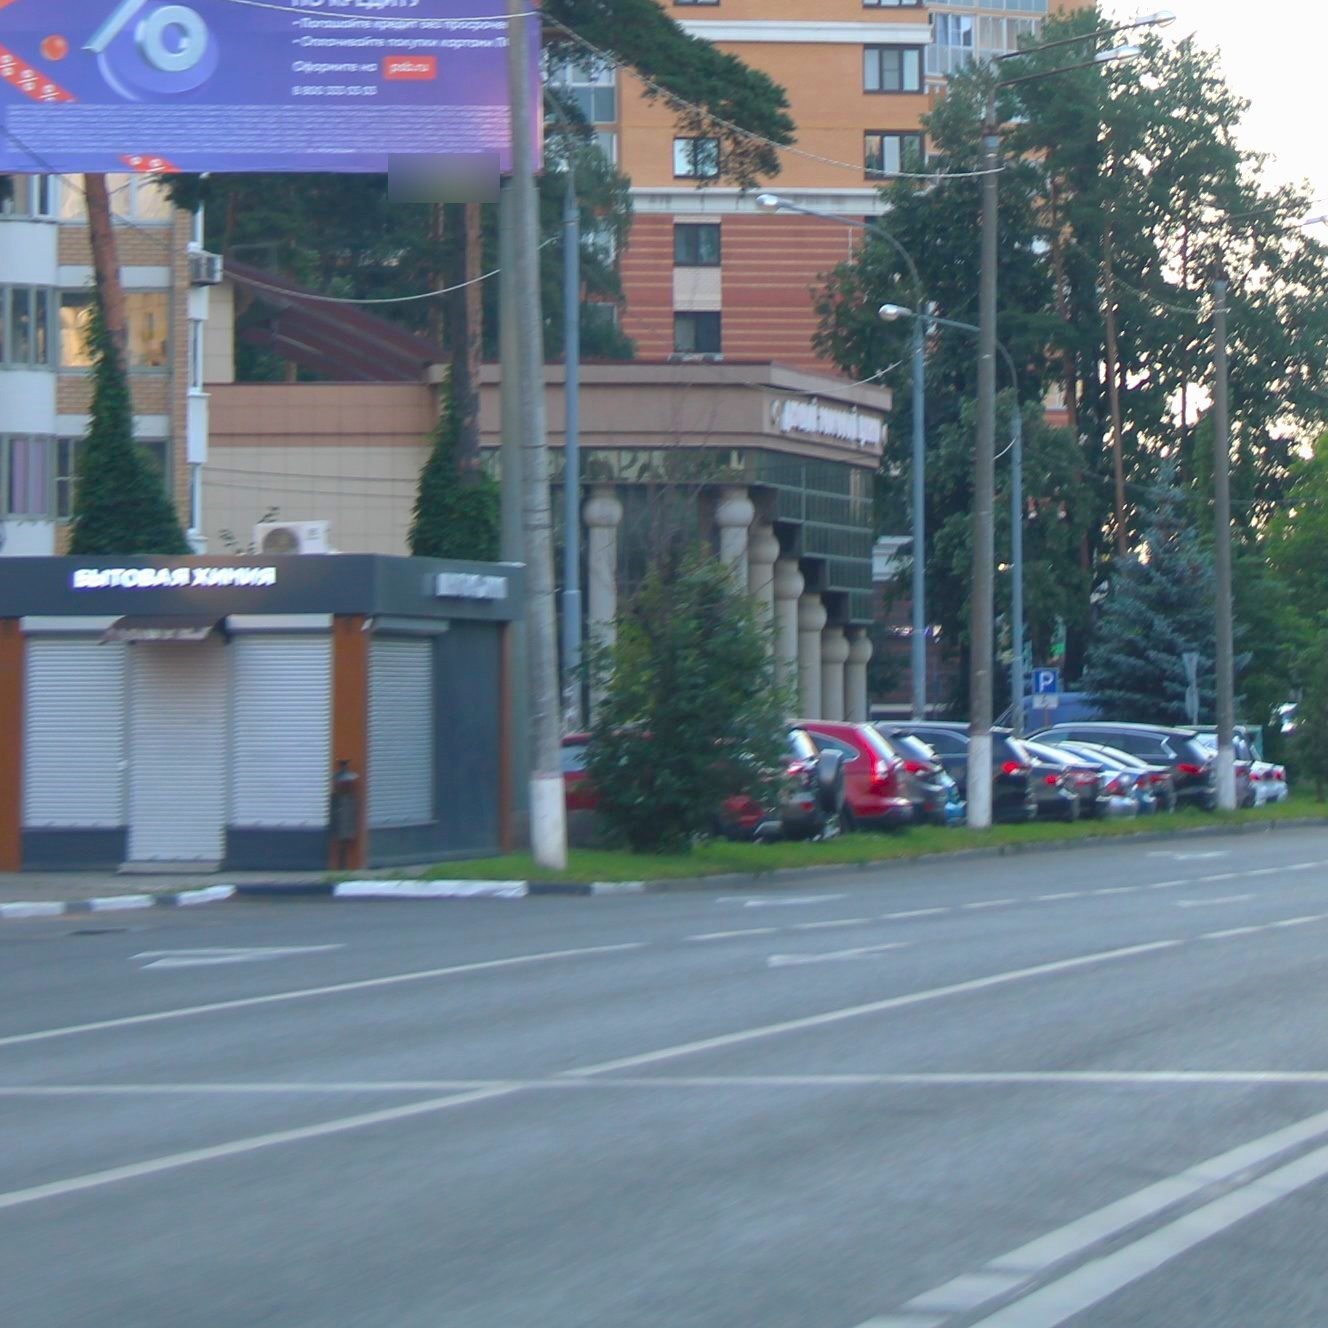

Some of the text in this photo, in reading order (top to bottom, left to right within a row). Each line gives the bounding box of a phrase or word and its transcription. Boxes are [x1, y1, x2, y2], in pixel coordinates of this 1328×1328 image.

[72, 567, 277, 588] БЫТОВАЯ ХИМИЯ
[1039, 671, 1054, 692] P
